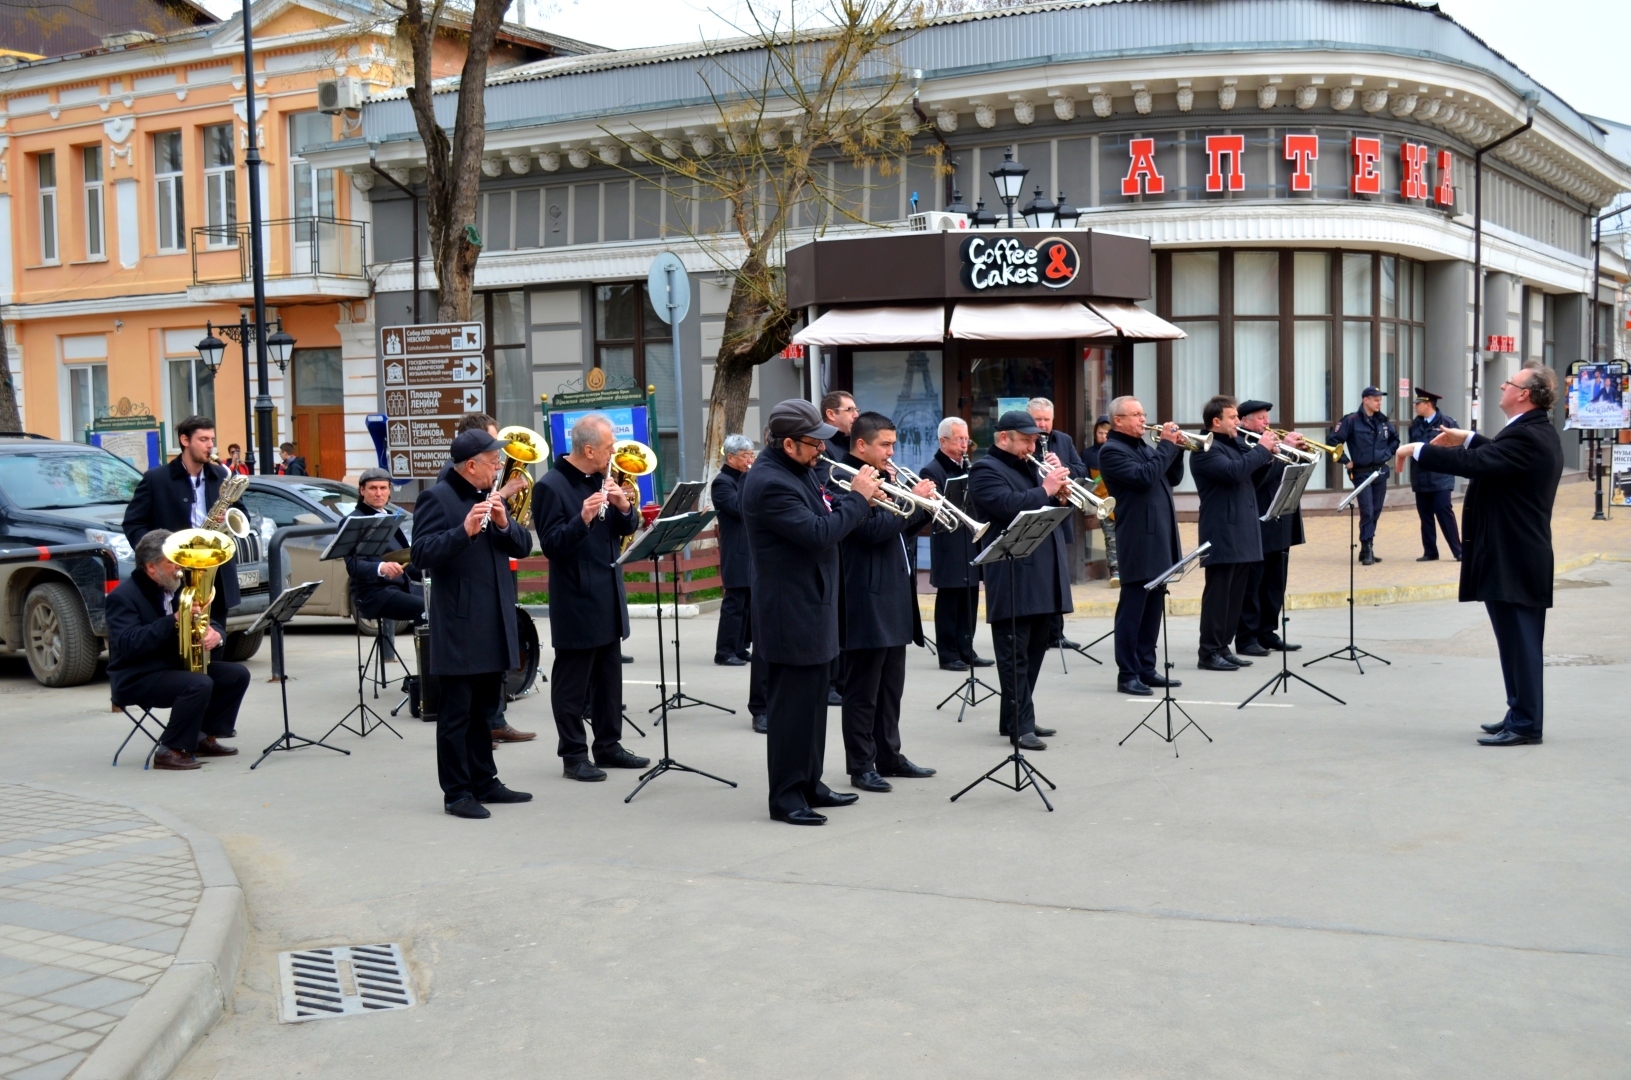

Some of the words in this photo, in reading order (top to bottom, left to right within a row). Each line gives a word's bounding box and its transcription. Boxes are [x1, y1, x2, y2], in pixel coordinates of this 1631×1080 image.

[1121, 134, 1454, 206] АПТЕКА
[969, 238, 1038, 265] Coffee
[1045, 243, 1074, 279] &
[971, 262, 1039, 289] Cakes
[421, 328, 451, 336] АЛЕКСАНДРА
[408, 358, 449, 366] ГОСУДАРСТВЕННЫЙ
[410, 390, 442, 399] Площадь
[411, 398, 439, 408] ЛЕНИНА
[423, 407, 438, 415] Square
[412, 421, 428, 430] Цирк
[412, 429, 444, 437] ТЕЗИКОВА
[413, 437, 430, 445] Circus
[430, 436, 453, 445] Tezikova
[414, 461, 432, 469] театр
